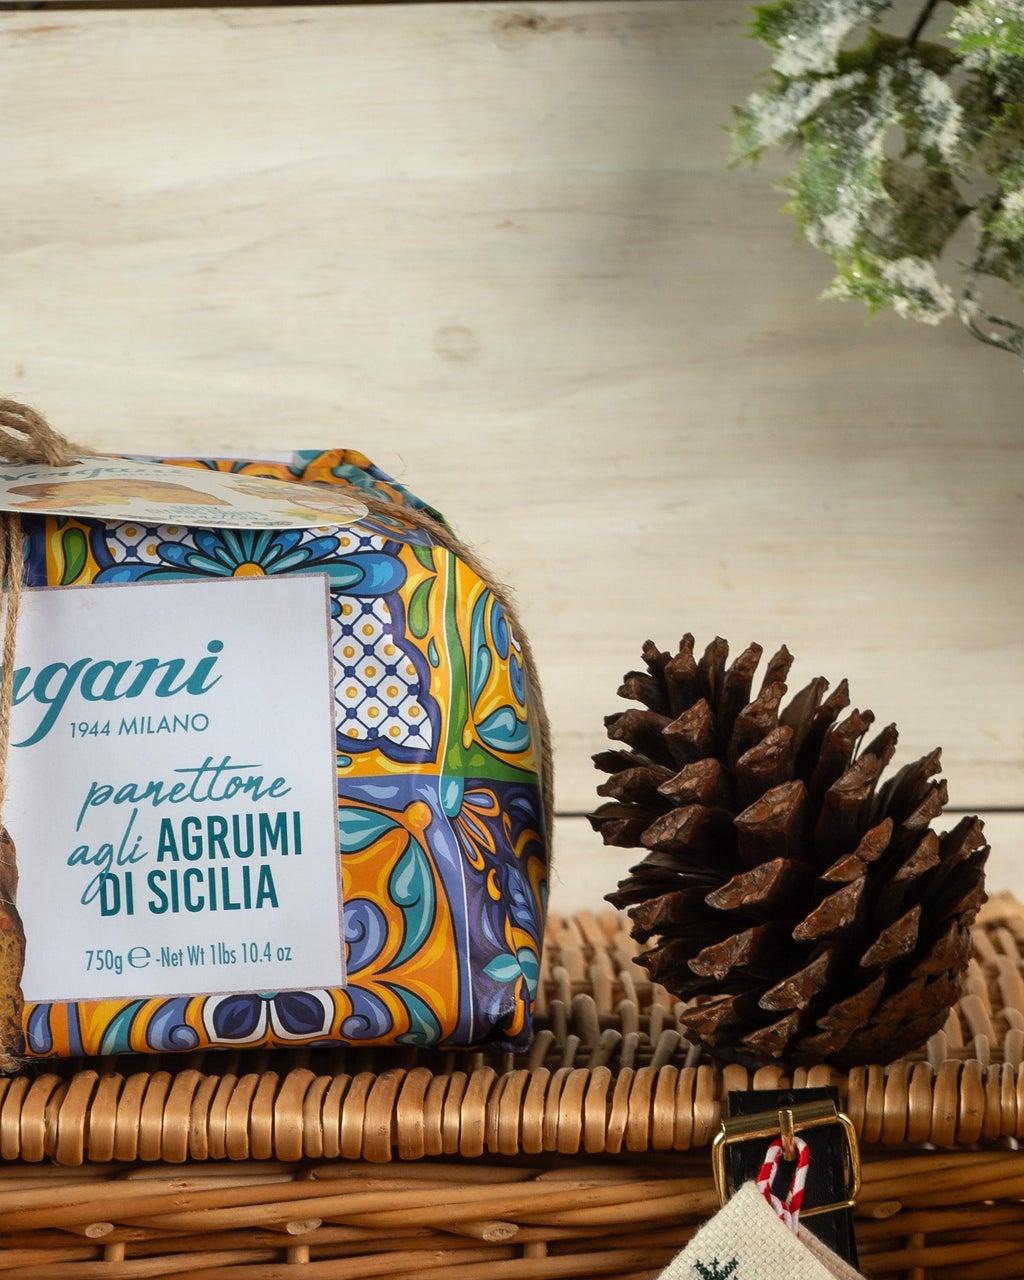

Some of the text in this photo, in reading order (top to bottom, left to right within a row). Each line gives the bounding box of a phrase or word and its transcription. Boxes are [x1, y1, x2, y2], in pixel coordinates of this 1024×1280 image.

[70, 713, 210, 738] 1944 MILANO
[75, 755, 292, 832] panettone
[66, 807, 303, 905] agli AGRUMI
[99, 864, 280, 916] DI SICILIA
[85, 949, 123, 975] 750g
[186, 944, 205, 966] Wt
[211, 942, 237, 965] 1lbs
[242, 941, 272, 964] 10.4
[276, 946, 293, 962] oz
